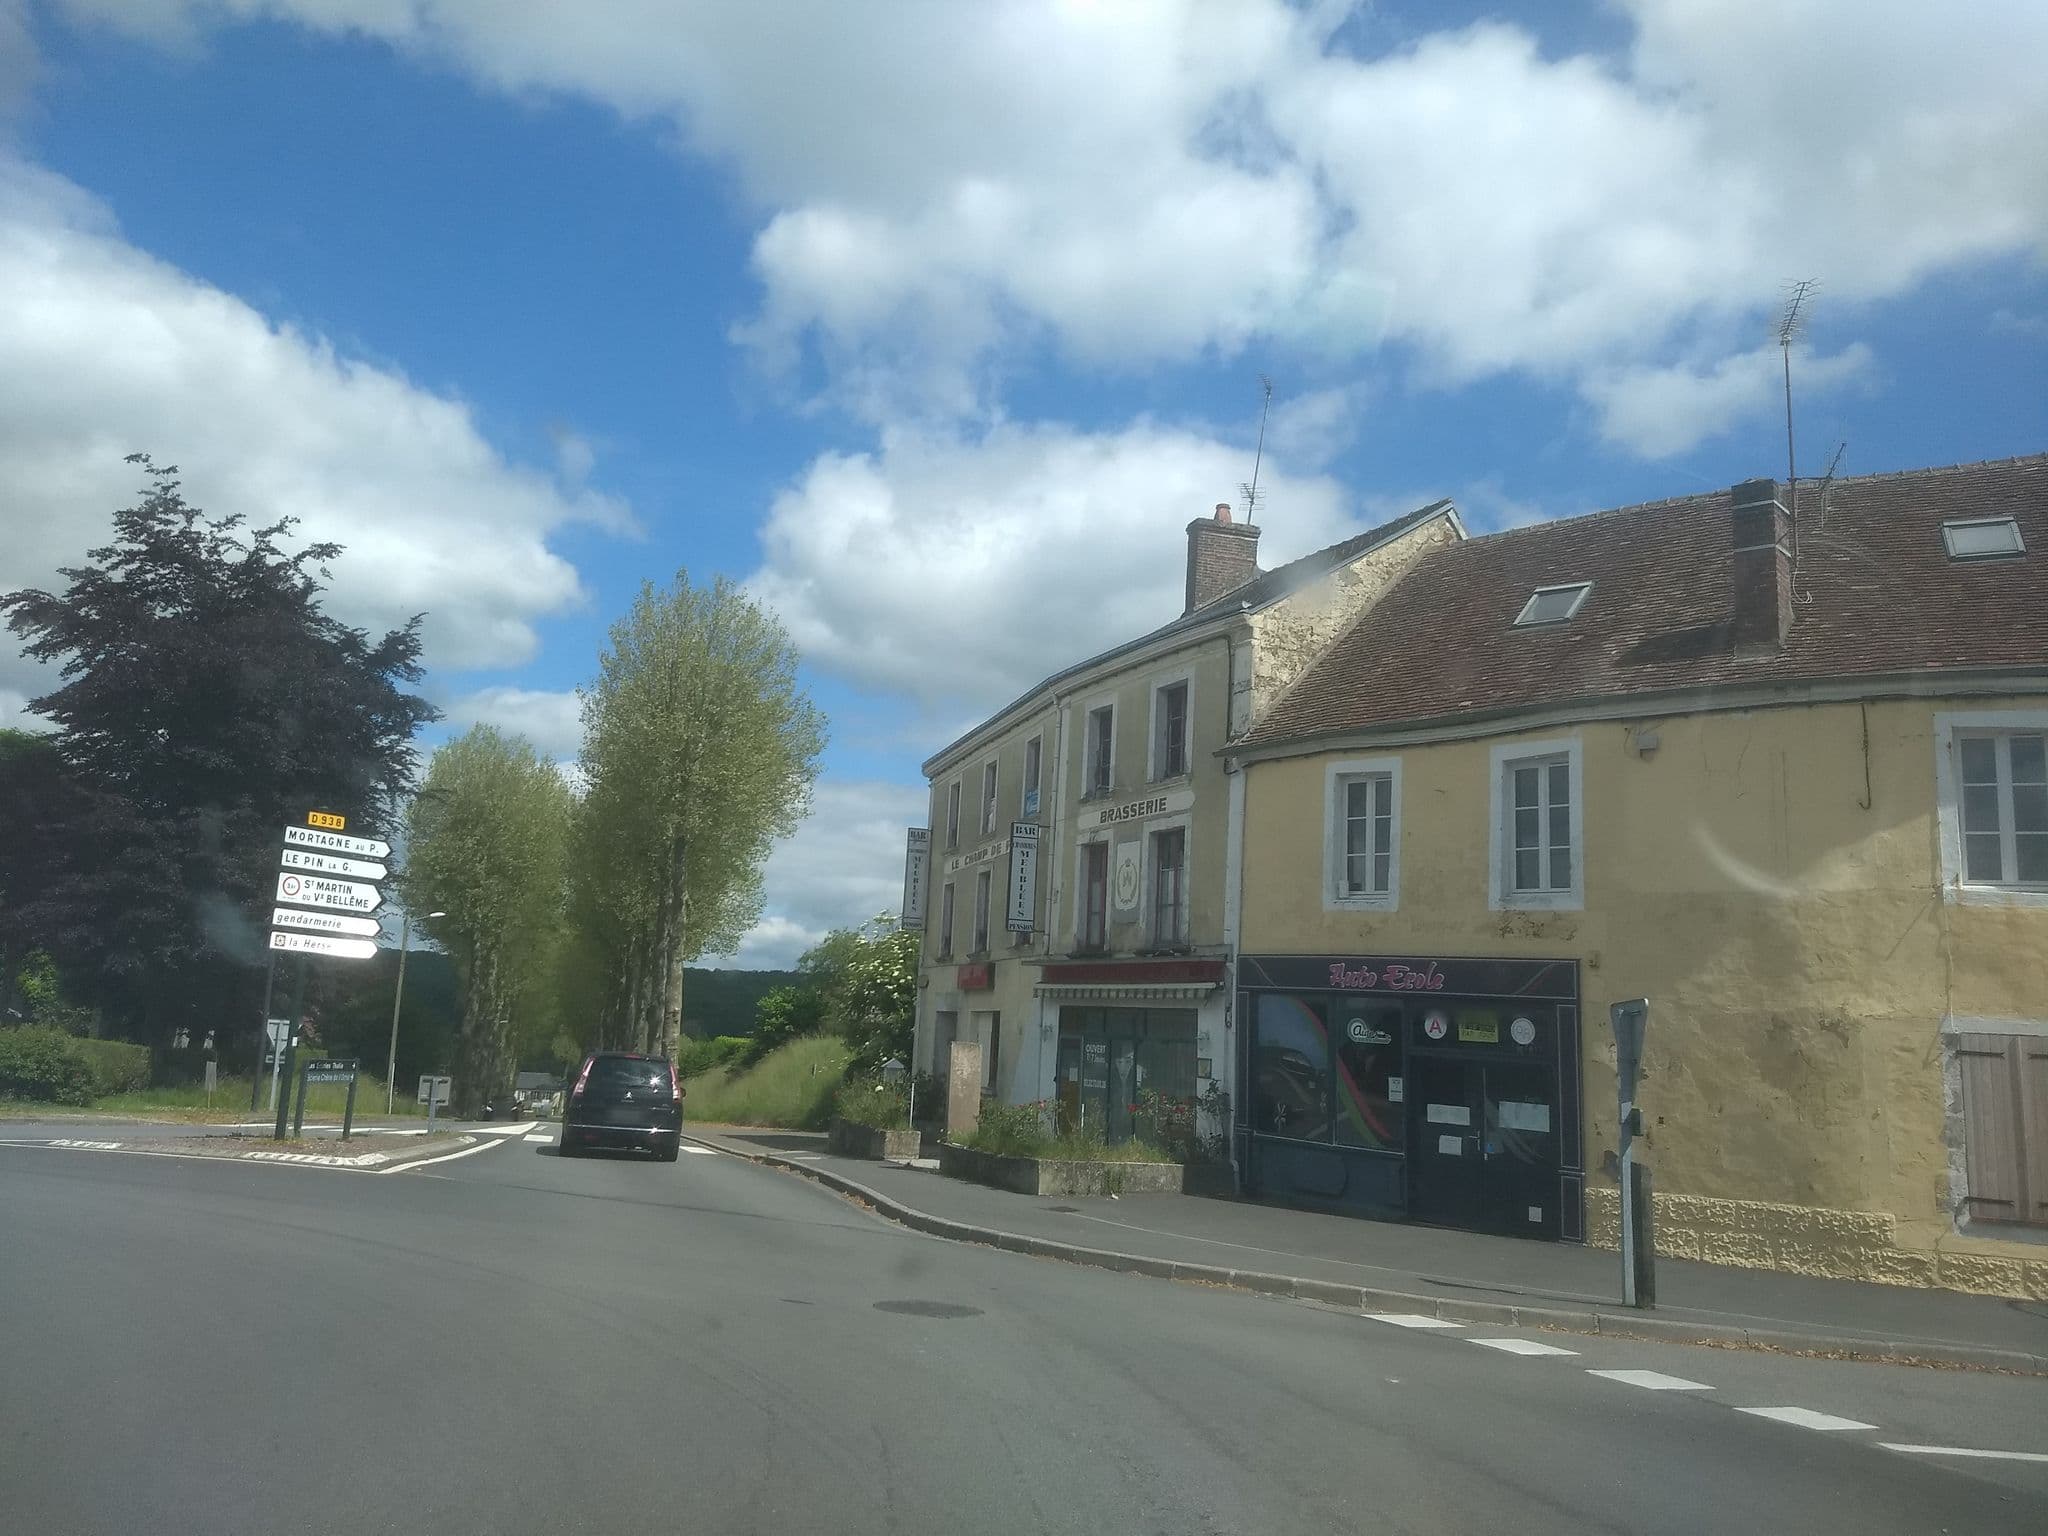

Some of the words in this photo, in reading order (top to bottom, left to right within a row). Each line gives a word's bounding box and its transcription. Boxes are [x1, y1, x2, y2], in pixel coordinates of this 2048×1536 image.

[1100, 797, 1168, 824] BRASSERIE
[311, 814, 318, 824] D
[321, 815, 342, 827] 938
[910, 830, 927, 840] BAR
[1015, 825, 1036, 836] BAR
[288, 830, 351, 849] MORTAGNE
[285, 853, 299, 864] LE
[303, 856, 324, 868] PIN
[951, 858, 960, 871] LE
[990, 842, 1002, 857] DE
[316, 881, 353, 895] MARTIN
[326, 895, 369, 909] BELLÊME
[276, 914, 342, 928] gendarmerie
[290, 937, 298, 947] la
[1329, 962, 1377, 988] Auto
